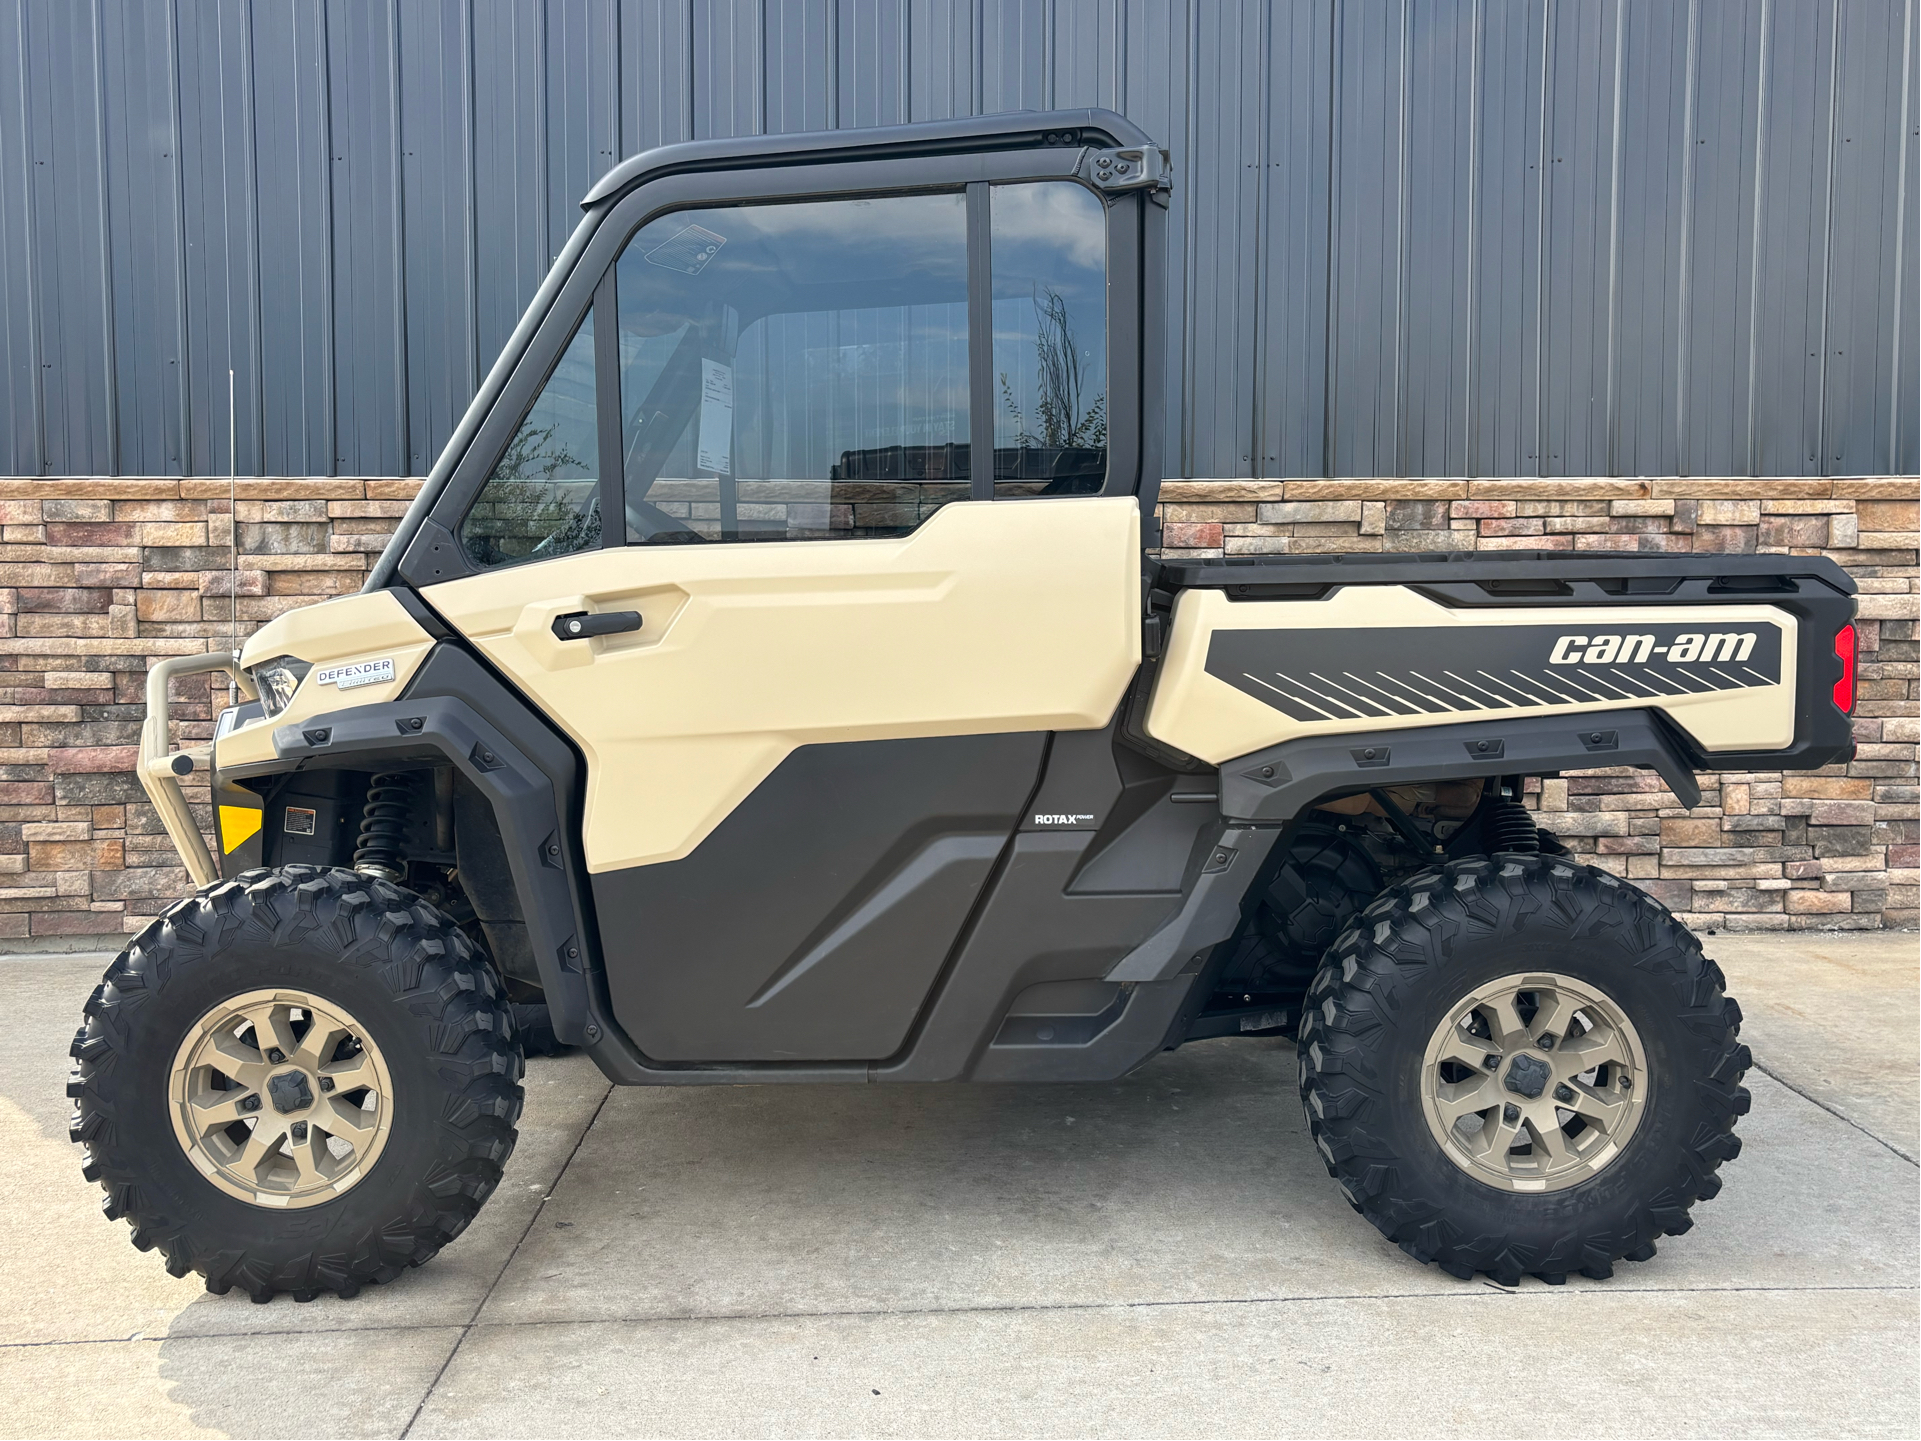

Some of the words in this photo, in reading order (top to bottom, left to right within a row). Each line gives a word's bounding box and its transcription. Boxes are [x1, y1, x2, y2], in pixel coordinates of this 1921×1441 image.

[1549, 632, 1757, 664] can-am
[319, 660, 390, 681] DEFENDER
[1035, 814, 1076, 824] ROTAX
